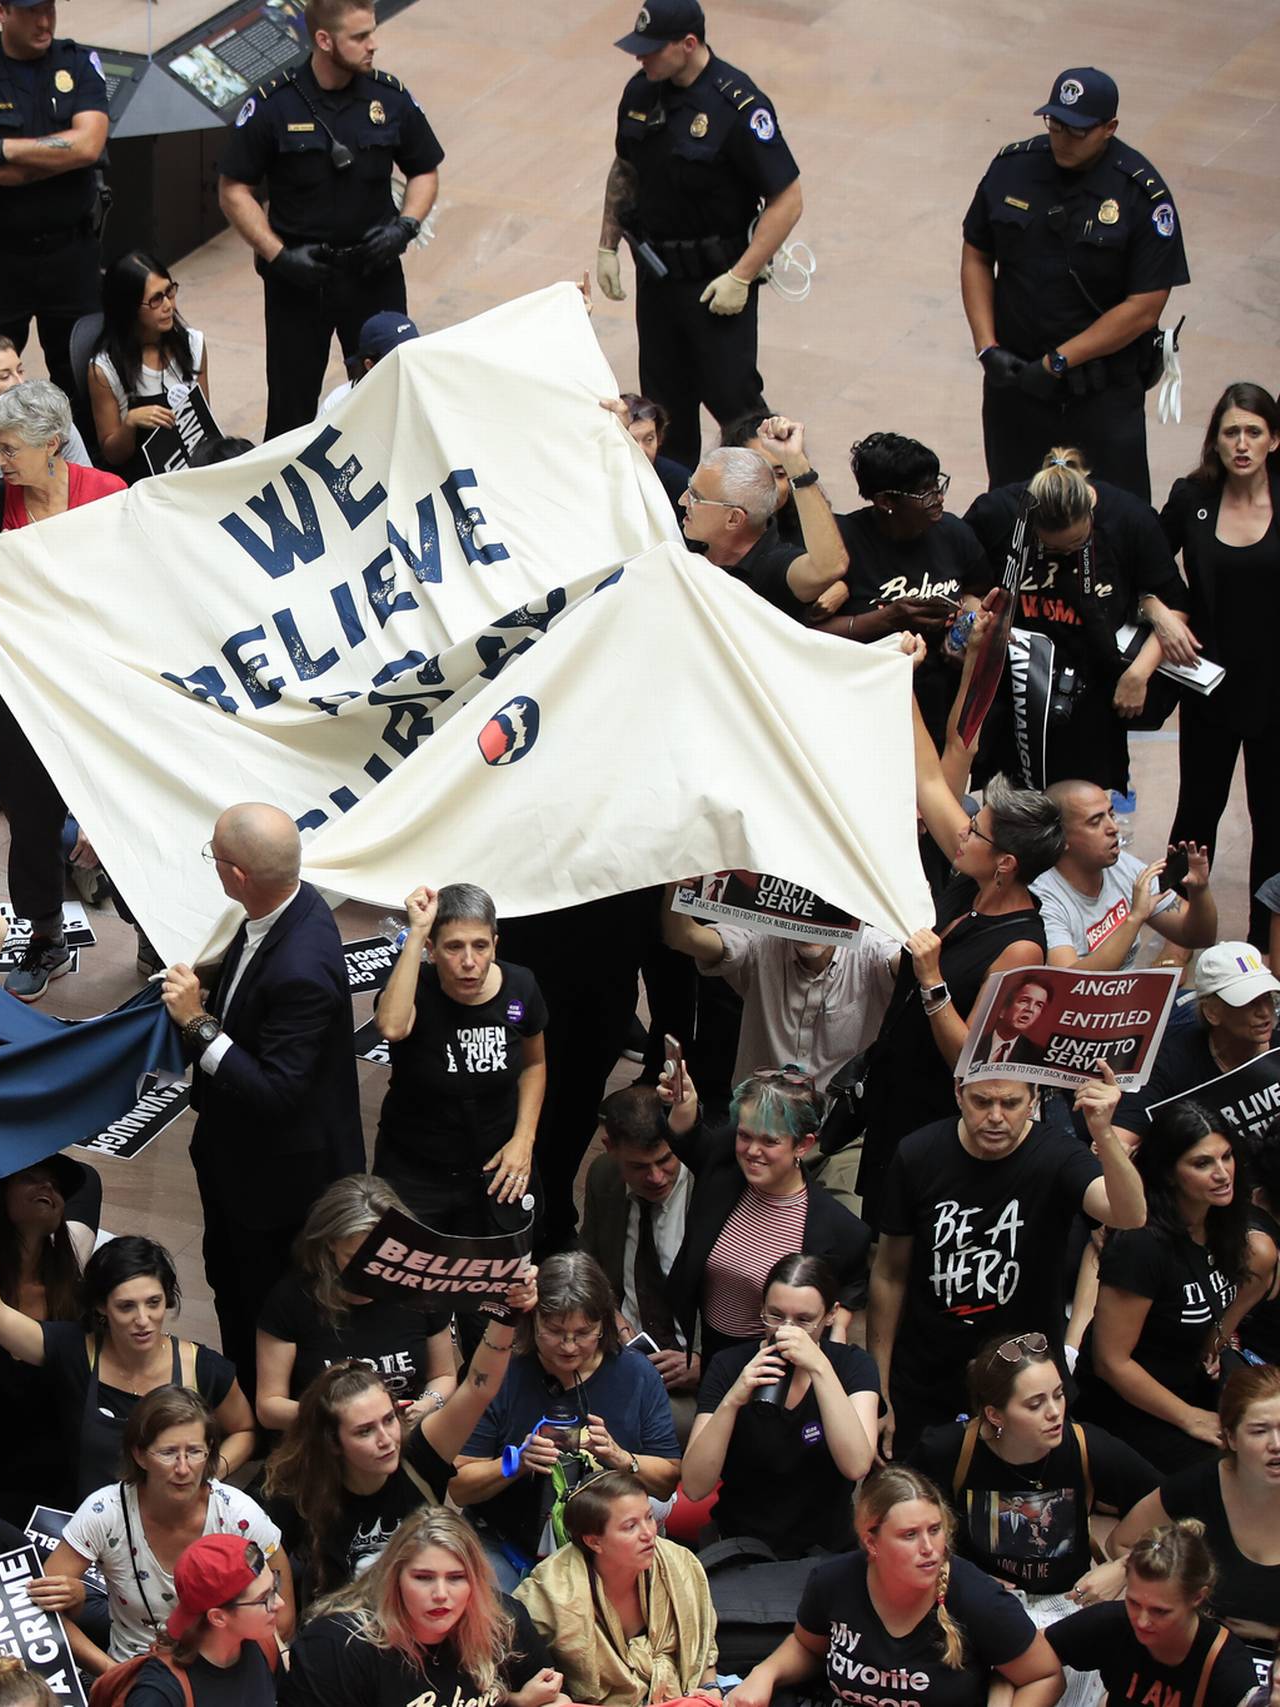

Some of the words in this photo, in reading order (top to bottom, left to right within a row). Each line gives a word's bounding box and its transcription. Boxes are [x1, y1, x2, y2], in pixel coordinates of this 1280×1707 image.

[219, 425, 388, 579] WE
[1083, 545, 1091, 575] DIGITA
[870, 572, 960, 605] Believe
[694, 898, 710, 912] TAKE
[710, 902, 732, 918] ACTION
[732, 908, 739, 918] TO
[739, 910, 756, 922] FIGHT
[756, 914, 773, 926] BACK
[755, 890, 816, 917] SERVE
[1087, 911, 1115, 947] ISSENT
[1116, 903, 1126, 920] IS
[344, 944, 400, 963] ABSOL
[357, 956, 393, 971] AND
[1071, 978, 1138, 997] ANGRY
[1059, 1010, 1151, 1029] ENTITLED
[1050, 1036, 1114, 1058] UNFIT
[1113, 1038, 1136, 1057] TO
[980, 1064, 995, 1073] TAKE
[995, 1063, 1017, 1073] ACTION
[1017, 1065, 1025, 1073] TO
[1025, 1066, 1043, 1077] FIGHT
[1043, 1068, 1061, 1079] BACK
[932, 1200, 983, 1250] BE
[984, 1199, 1024, 1258] A
[375, 1237, 533, 1279] BELIEVE
[929, 1246, 1020, 1308] HERO
[324, 1350, 415, 1373] TE
[1022, 1564, 1033, 1579] AT
[1037, 1562, 1049, 1578] ME
[830, 1621, 861, 1653] My
[45, 1670, 71, 1693] A
[1126, 1672, 1138, 1699] I
[406, 1685, 500, 1707] Blieve
